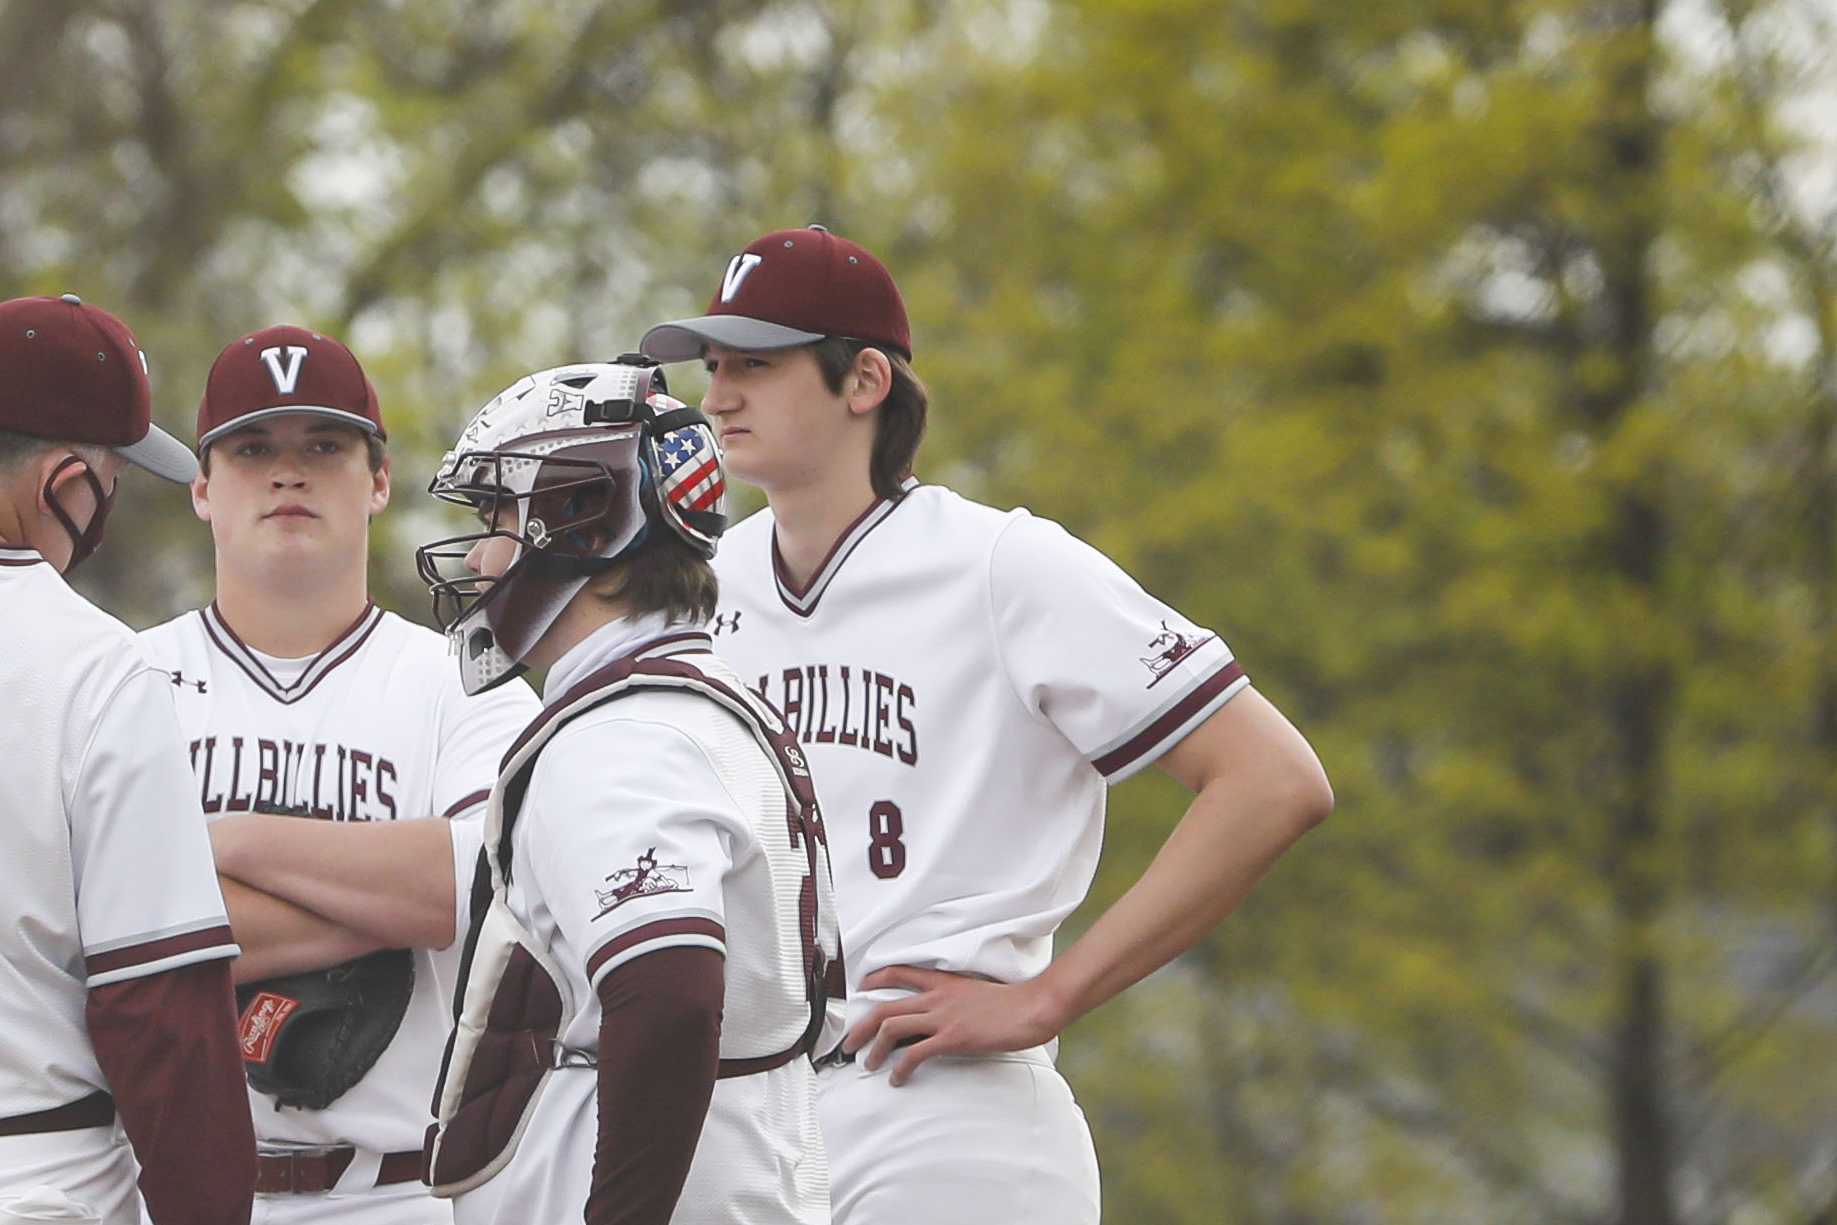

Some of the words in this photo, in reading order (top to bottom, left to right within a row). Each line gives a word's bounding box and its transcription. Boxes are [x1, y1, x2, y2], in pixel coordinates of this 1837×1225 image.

[719, 252, 764, 304] V
[259, 345, 309, 395] V
[759, 664, 918, 768] BILLIES
[868, 799, 907, 881] 8
